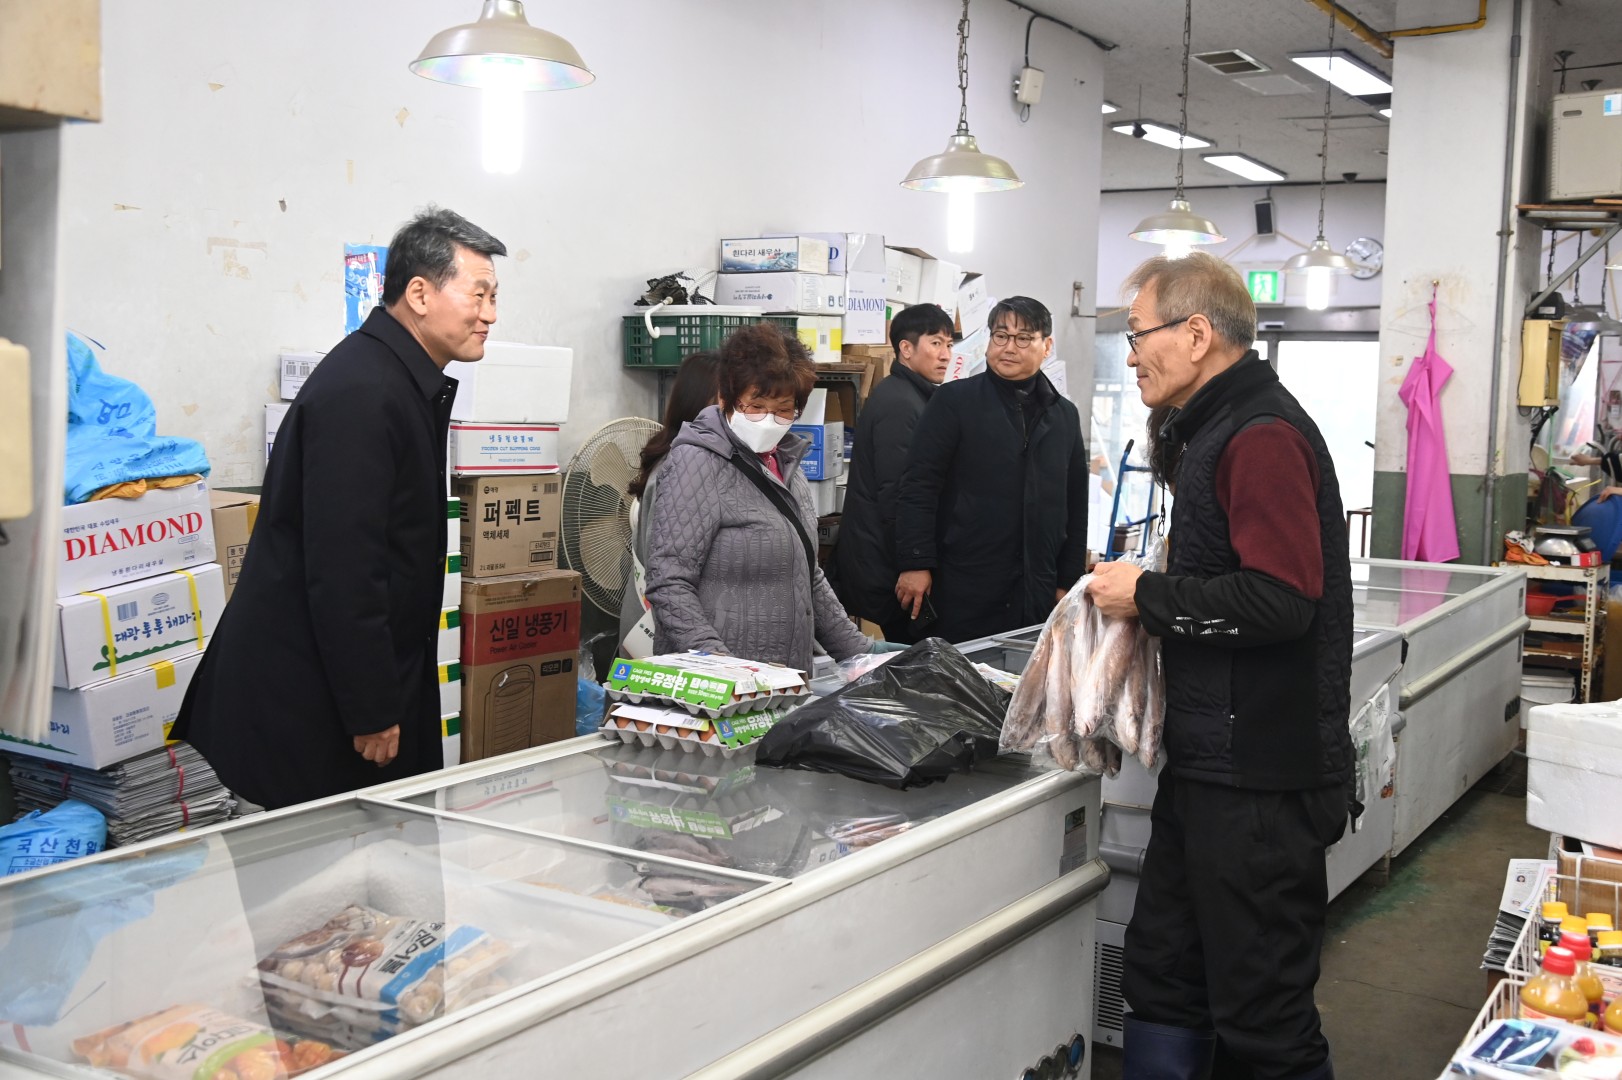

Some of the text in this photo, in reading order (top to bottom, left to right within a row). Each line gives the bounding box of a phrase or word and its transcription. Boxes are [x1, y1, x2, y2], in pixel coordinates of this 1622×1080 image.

[732, 248, 756, 257] 흰다리
[848, 297, 885, 312] DIAMOND
[483, 498, 541, 527] 퍼펙트
[63, 511, 203, 562] DIAMOND
[482, 528, 510, 540] 액체세제
[489, 609, 568, 643] 신일 냉풍기
[489, 641, 538, 655] Power Air Cooler
[632, 667, 643, 675] CAGE
[650, 671, 688, 691] 유정란
[50, 721, 70, 735] 파리
